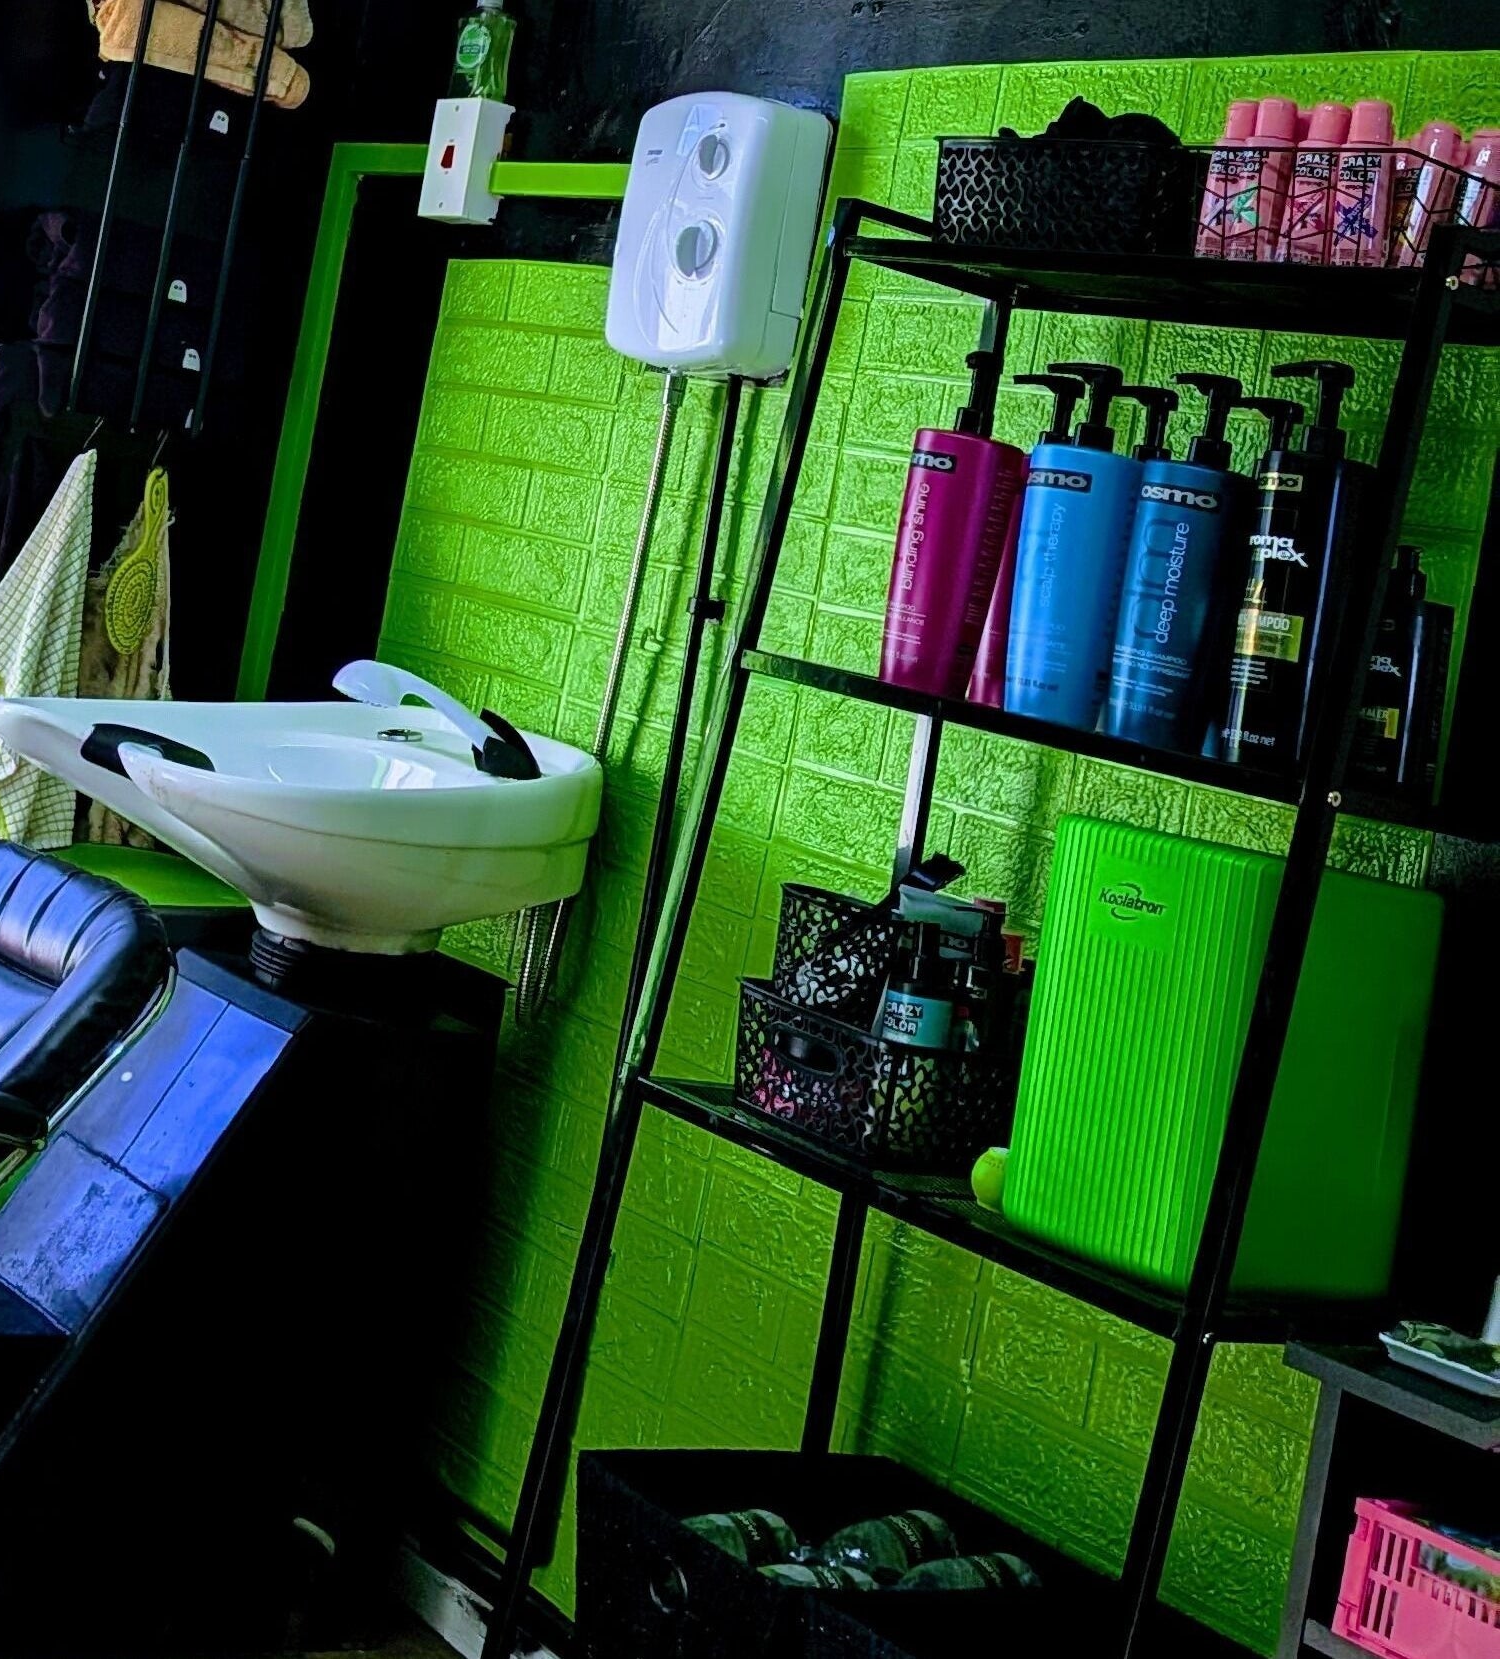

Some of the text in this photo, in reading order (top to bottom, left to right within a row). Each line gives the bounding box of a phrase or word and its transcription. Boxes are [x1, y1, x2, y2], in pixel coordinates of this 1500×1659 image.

[1342, 156, 1380, 168] CRAZY
[1141, 485, 1218, 509] osmo
[901, 482, 930, 591] blinding shine
[1043, 503, 1067, 561] therapy
[1040, 567, 1057, 608] scalp
[1155, 522, 1190, 644] deep moisture
[1098, 887, 1168, 916] Koolatron
[885, 1001, 923, 1017] CRAZY
